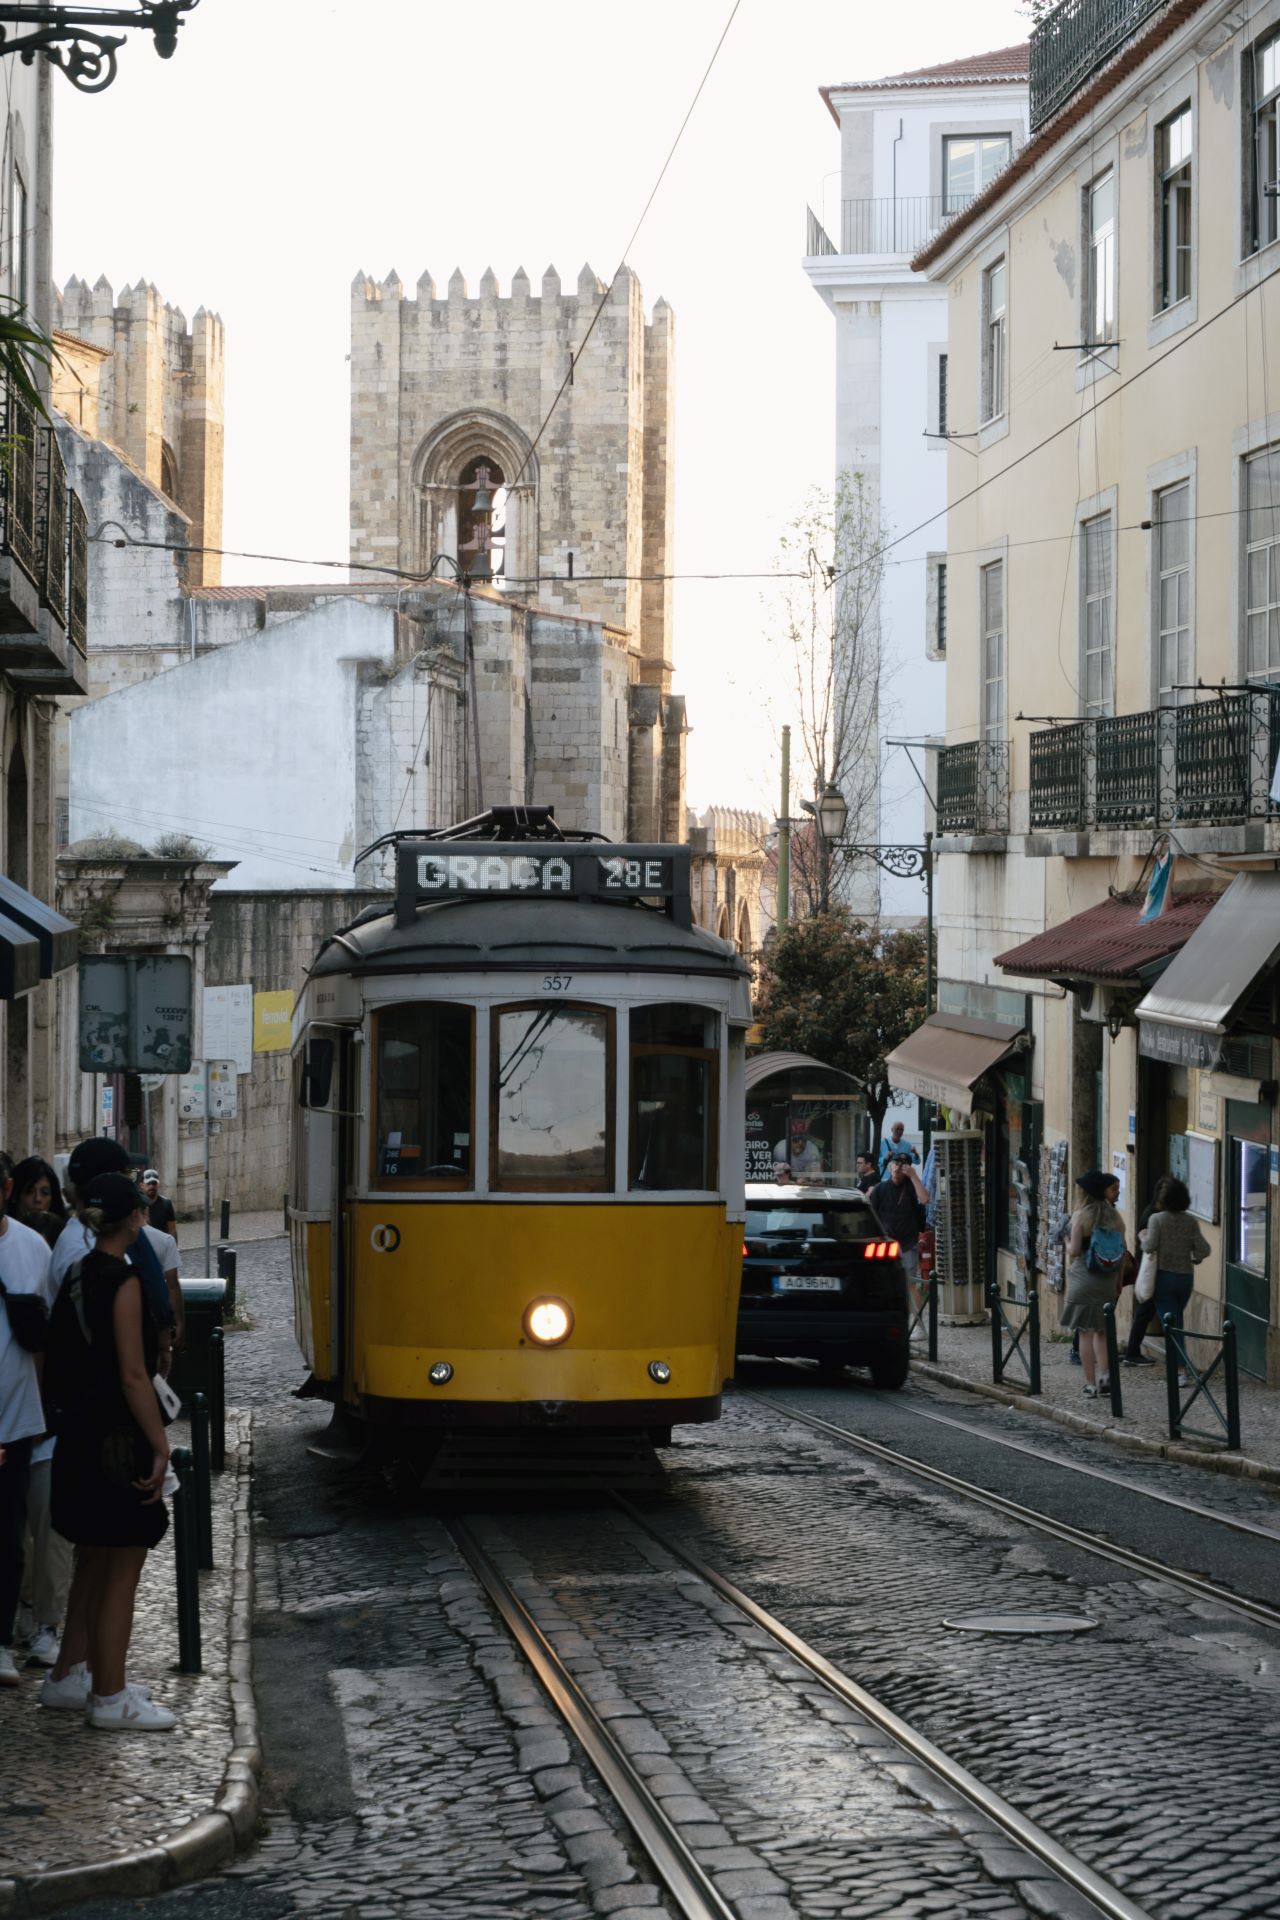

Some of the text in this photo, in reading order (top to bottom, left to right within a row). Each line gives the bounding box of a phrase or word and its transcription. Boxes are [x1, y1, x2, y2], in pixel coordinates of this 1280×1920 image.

[417, 855, 662, 890] GRAÇA 28E
[542, 976, 573, 991] 557
[752, 1151, 772, 1160] VER
[386, 1163, 398, 1174] 16
